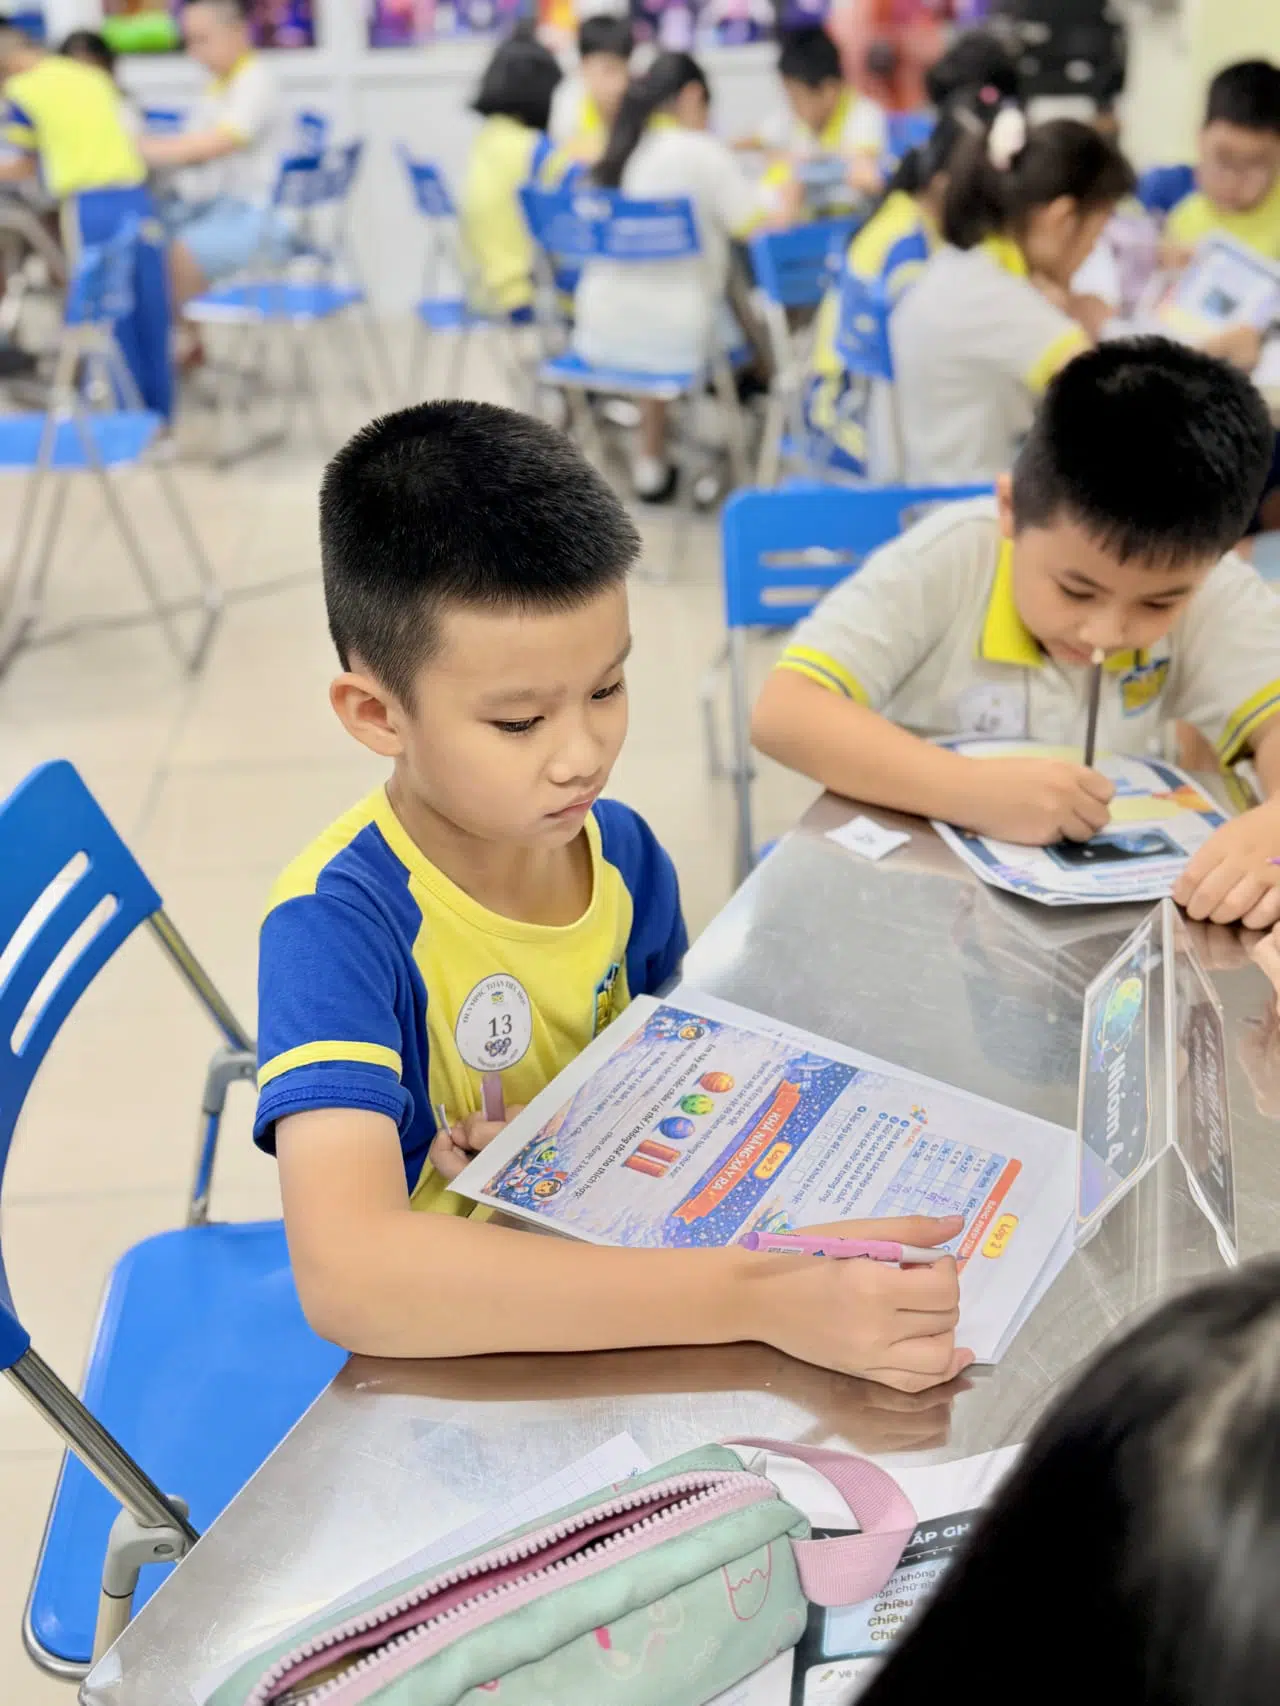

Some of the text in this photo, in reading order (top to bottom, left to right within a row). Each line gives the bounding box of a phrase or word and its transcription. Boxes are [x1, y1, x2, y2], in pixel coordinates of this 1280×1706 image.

[488, 1013, 513, 1038] 13
[1106, 1051, 1127, 1139] Nhóm
[641, 1111, 656, 1123] thể
[620, 1125, 642, 1144] không
[611, 1144, 627, 1156] thể
[711, 1112, 783, 1190] KHẢ NĂNG XẢY RA
[602, 1155, 616, 1167] cho
[587, 1167, 605, 1183] thích
[993, 1223, 1009, 1240] Lớp
[900, 1570, 937, 1583] không
[874, 1599, 914, 1613] Chiều
